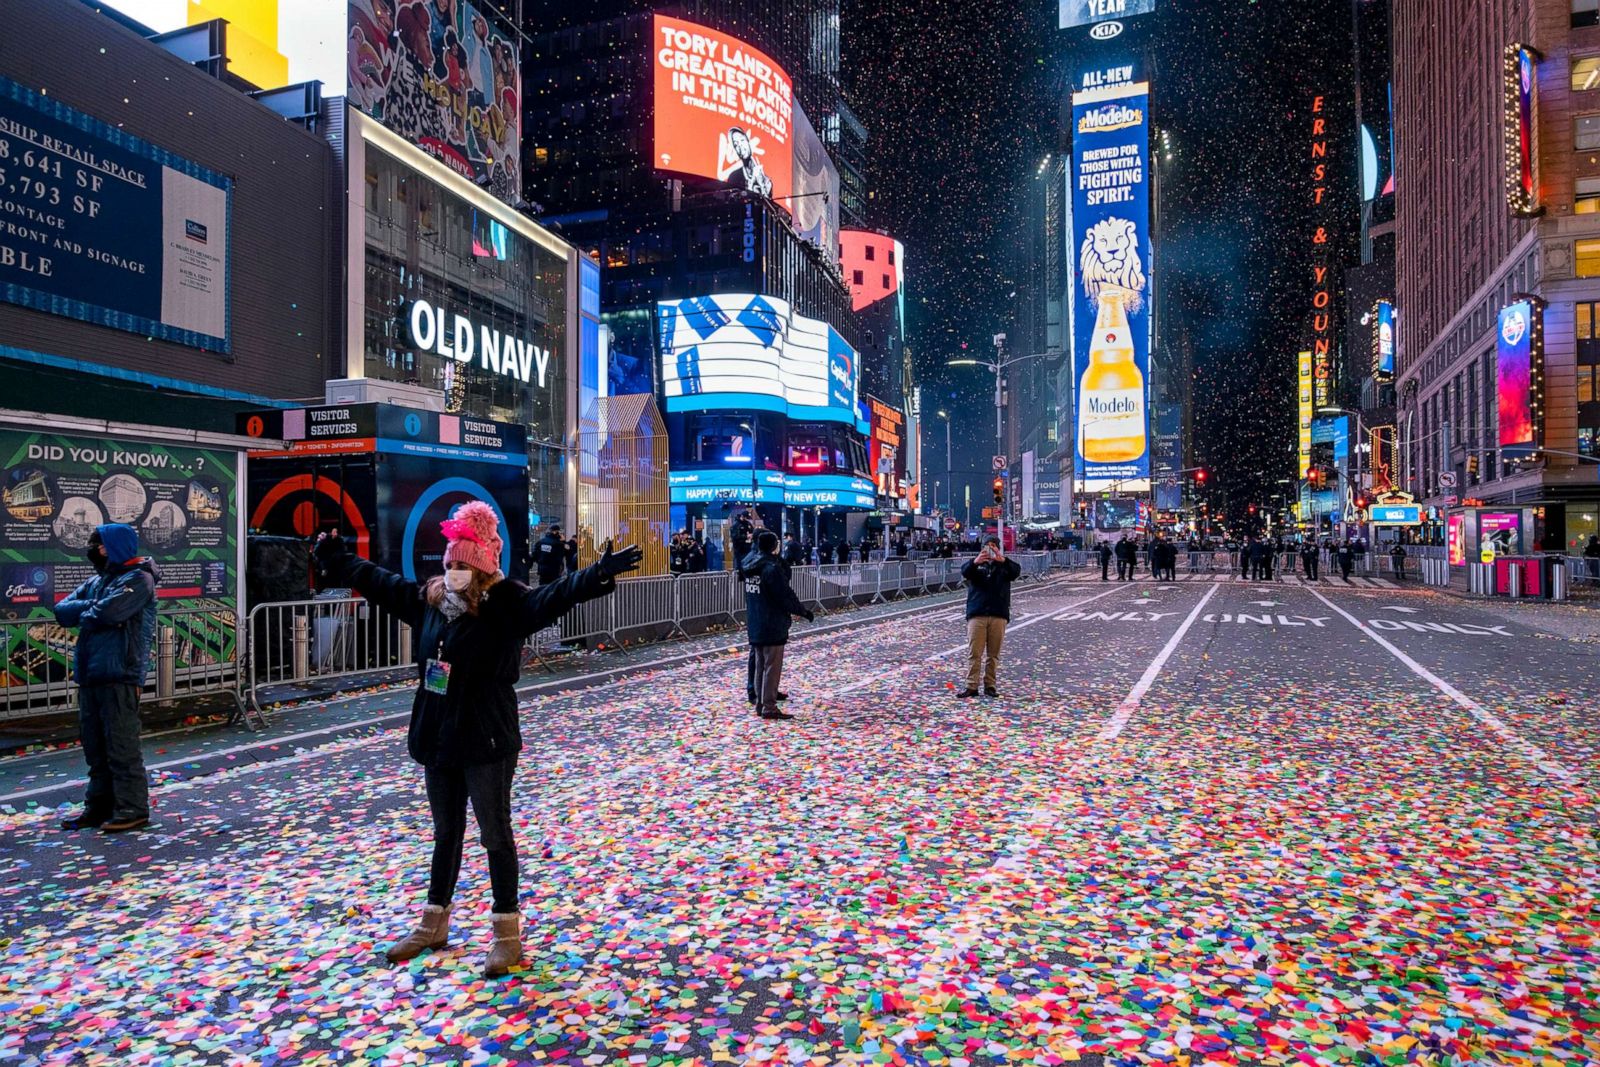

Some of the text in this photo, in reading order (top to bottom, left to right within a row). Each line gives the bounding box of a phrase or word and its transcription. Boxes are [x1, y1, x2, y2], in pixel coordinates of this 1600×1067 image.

[1088, 0, 1126, 17] YEAR
[1096, 25, 1118, 36] KIA
[661, 27, 792, 103] TORY LANEZ THE
[1082, 65, 1133, 87] ALL-NEW
[658, 49, 792, 122] GREATEST ARTIST
[672, 71, 696, 94] IN
[700, 78, 738, 107] THE
[683, 95, 737, 118] STREAM NOW
[1086, 106, 1134, 128] Modelo
[42, 133, 98, 167] RETAIL
[102, 158, 146, 187] SPACE
[1083, 144, 1138, 162] BREWED FOR
[0, 138, 103, 193] 8,641 SF
[1080, 156, 1141, 174] THOSE WITH A
[1079, 168, 1142, 190] FIGHTING
[73, 194, 101, 219] SF
[1087, 186, 1135, 206] SPIRIT.
[743, 203, 755, 263] 1500
[1312, 96, 1329, 382] ERNST & YOUNG
[0, 244, 53, 278] BLE
[53, 237, 83, 255] AND
[87, 248, 146, 275] SIGNAGE
[411, 299, 550, 388] OLD NAVY
[311, 410, 350, 422] VISITOR
[1088, 397, 1135, 413] Modelo
[311, 423, 358, 436] SERVICES
[464, 420, 497, 435] VISITOR
[464, 433, 503, 448] SERVICES
[28, 444, 65, 461] DID
[69, 447, 108, 464] YOU
[113, 451, 168, 468] KNOW
[686, 488, 763, 498] HAPPY NEW YEAR
[793, 493, 813, 502] NEW
[815, 493, 837, 502] YEAR
[1052, 611, 1180, 621] ONLY
[1203, 612, 1331, 627] ONLY
[1368, 619, 1514, 636] ONLY
